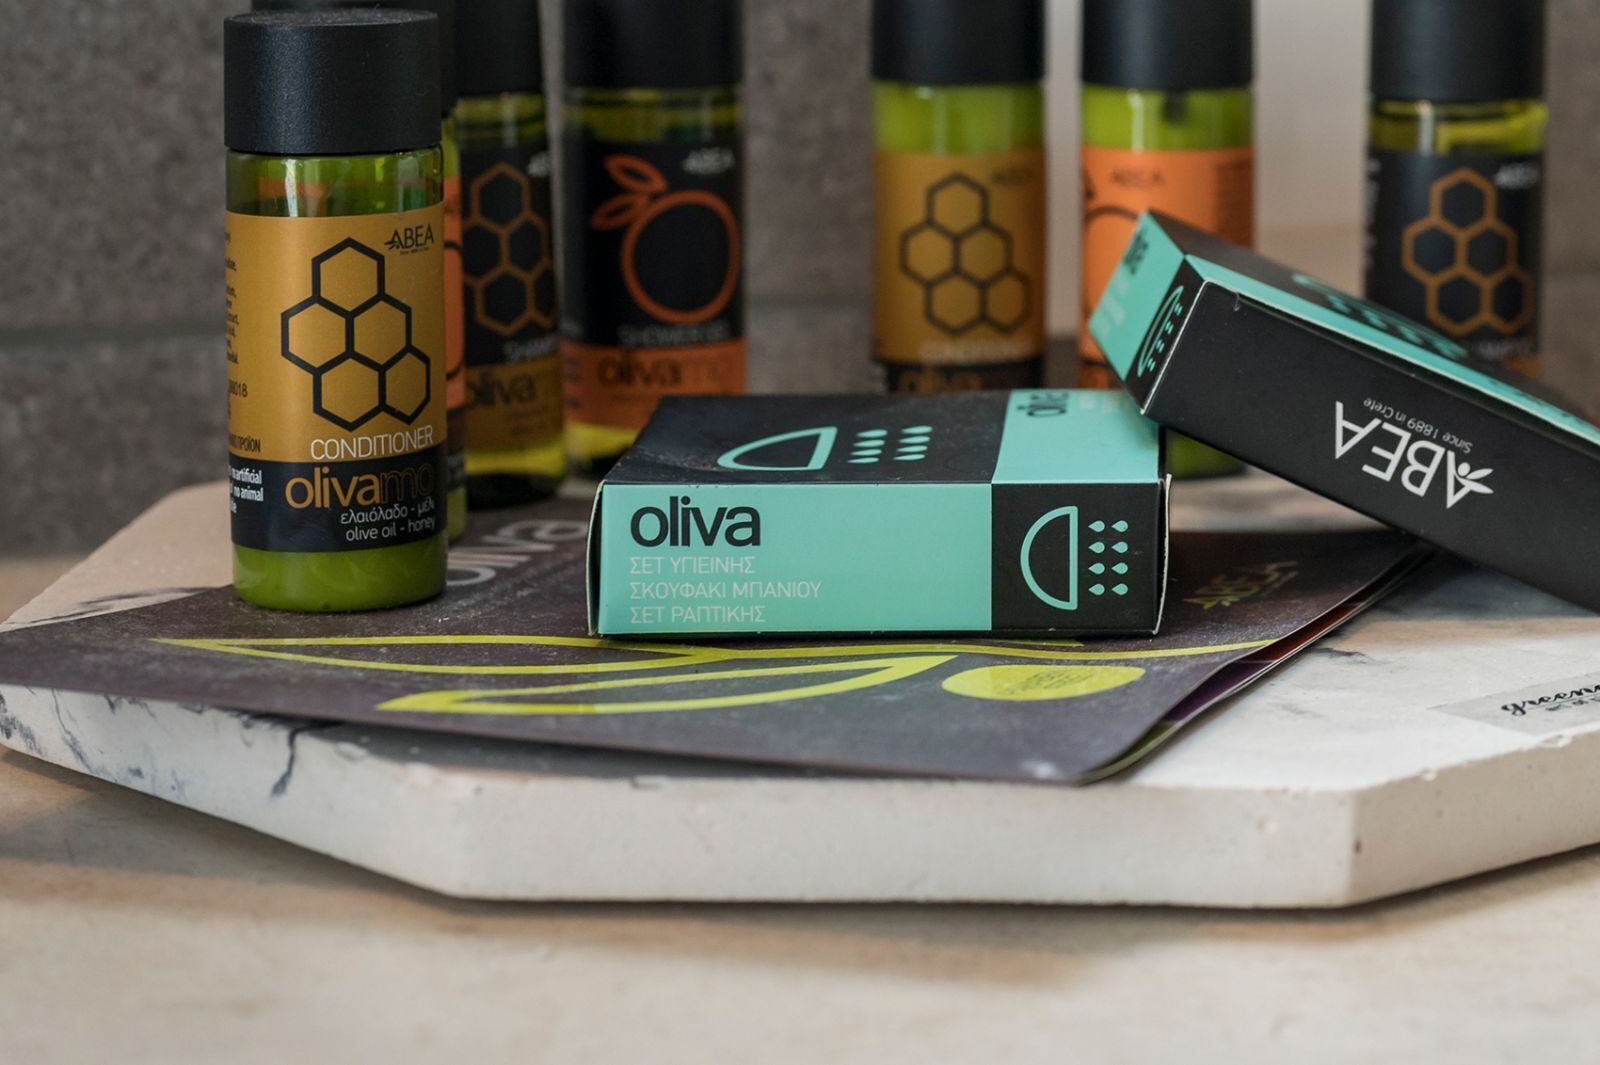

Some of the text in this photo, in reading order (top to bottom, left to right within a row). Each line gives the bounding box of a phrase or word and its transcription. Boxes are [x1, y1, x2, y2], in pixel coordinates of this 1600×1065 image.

[384, 224, 434, 249] ABEA
[1363, 397, 1473, 454] Since 1889 in Crete
[310, 425, 433, 460] CONDITIONER
[1335, 400, 1494, 509] ABEA
[241, 485, 264, 502] animal
[340, 503, 408, 525] ελαιόλαδο
[630, 495, 761, 547] oliva
[346, 527, 379, 542] olive
[381, 523, 397, 538] oil
[408, 517, 436, 534] honey
[630, 556, 664, 575] ΣΕΤ
[630, 581, 822, 600] ΣΚΟΥΦΑΚΙ ΜΠΑΝΙΟΥ
[630, 605, 766, 624] ΣΕΤ ΡΑΠΤΙΚΗΣ
